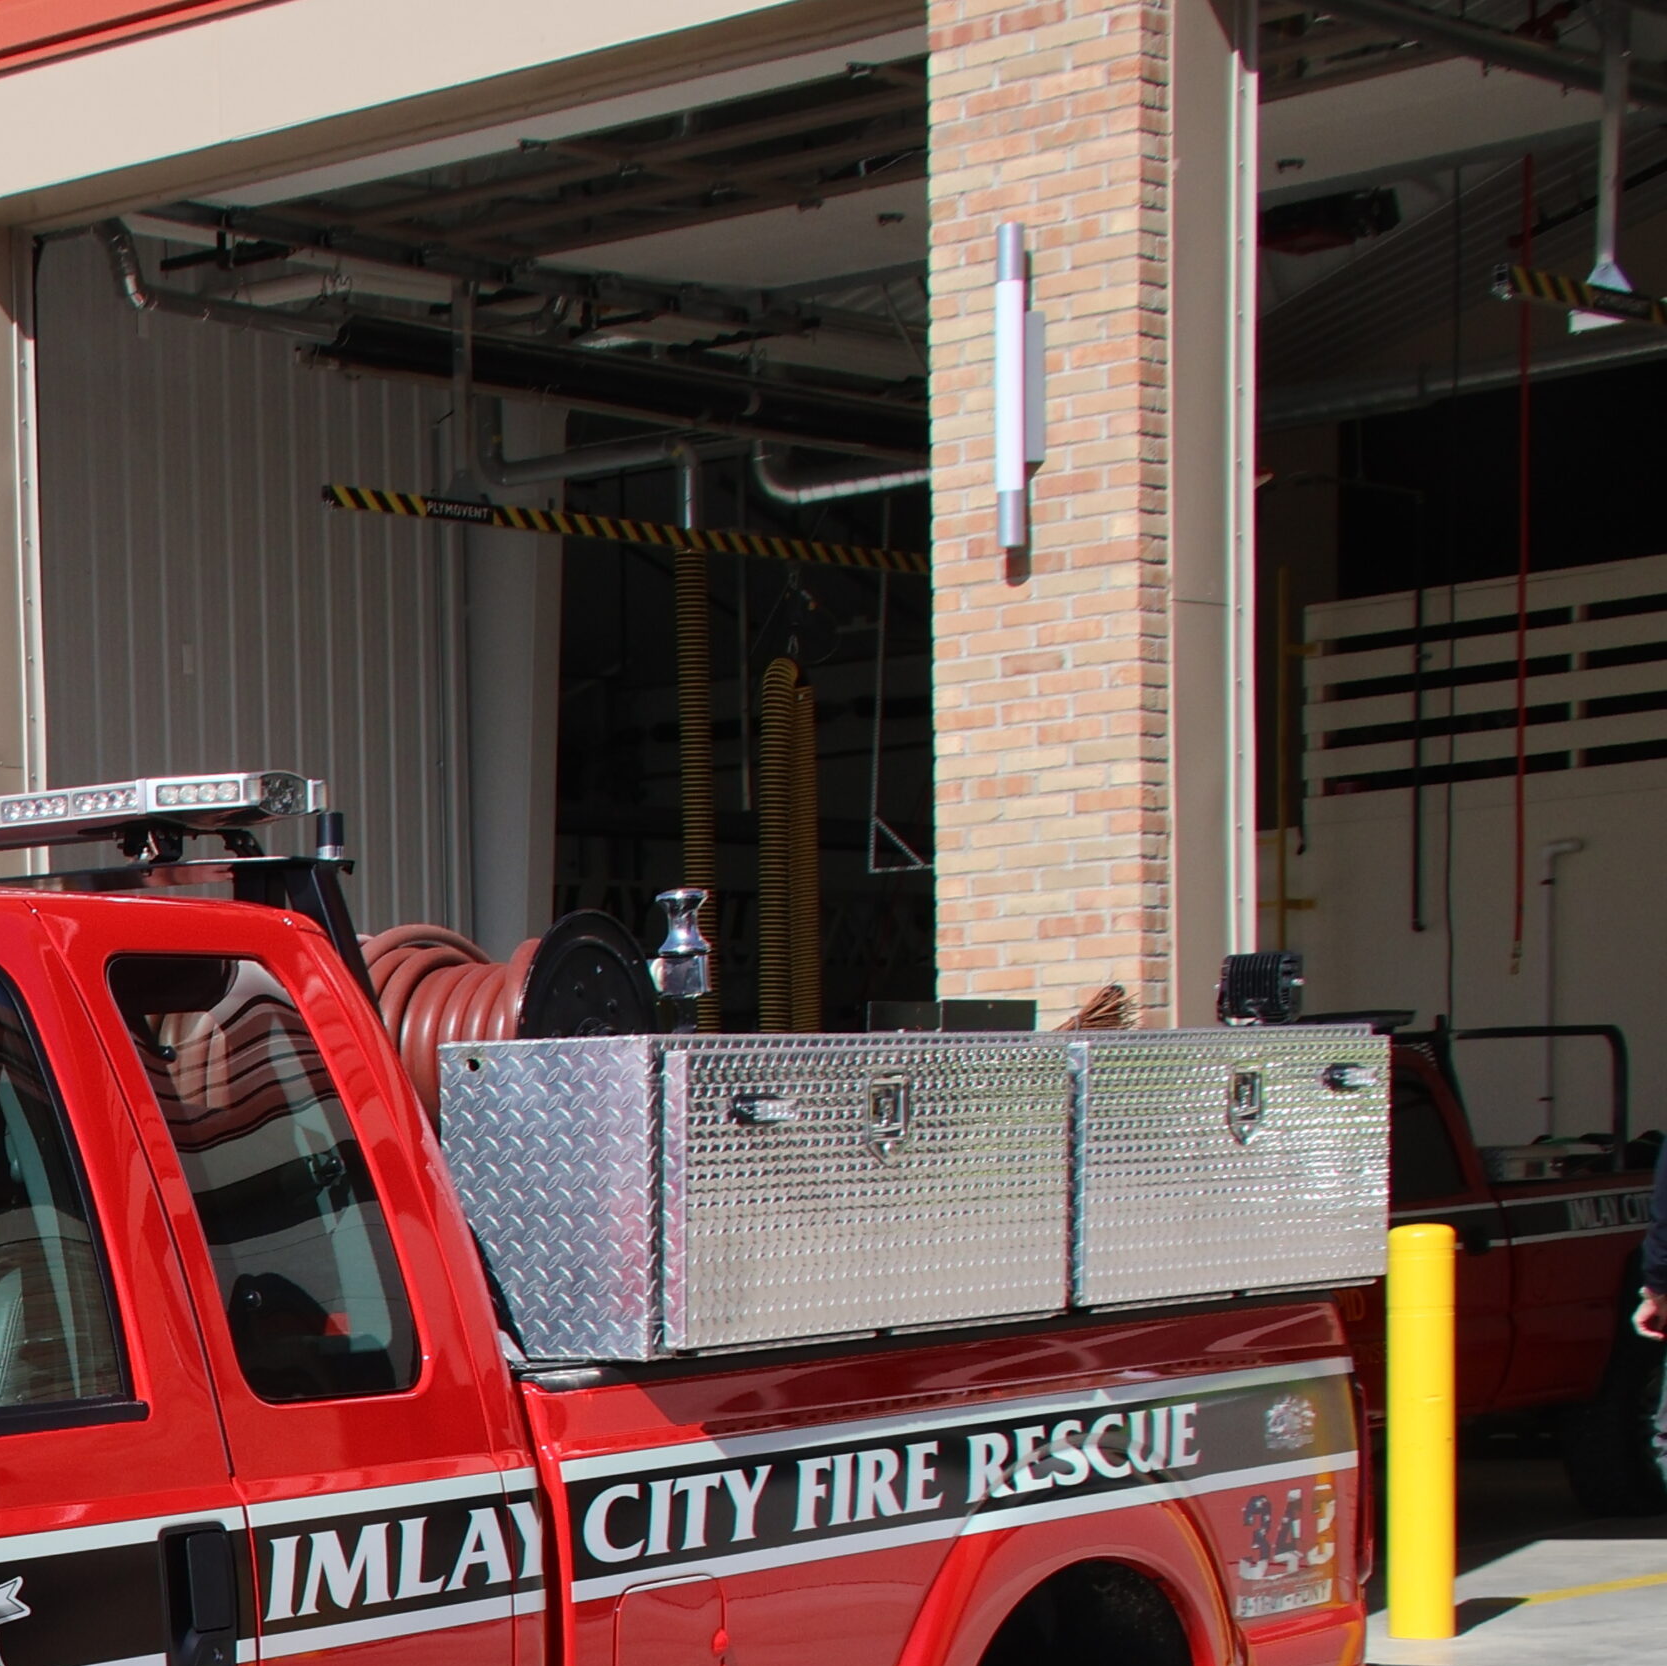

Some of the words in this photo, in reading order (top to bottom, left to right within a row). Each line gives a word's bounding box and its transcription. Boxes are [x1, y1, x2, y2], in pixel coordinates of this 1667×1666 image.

[263, 1500, 543, 1622] IMLAY
[583, 1464, 773, 1564] CITY
[792, 1440, 943, 1533] FIRE
[965, 1402, 1202, 1504] RESCUE
[1239, 1484, 1336, 1580] 343
